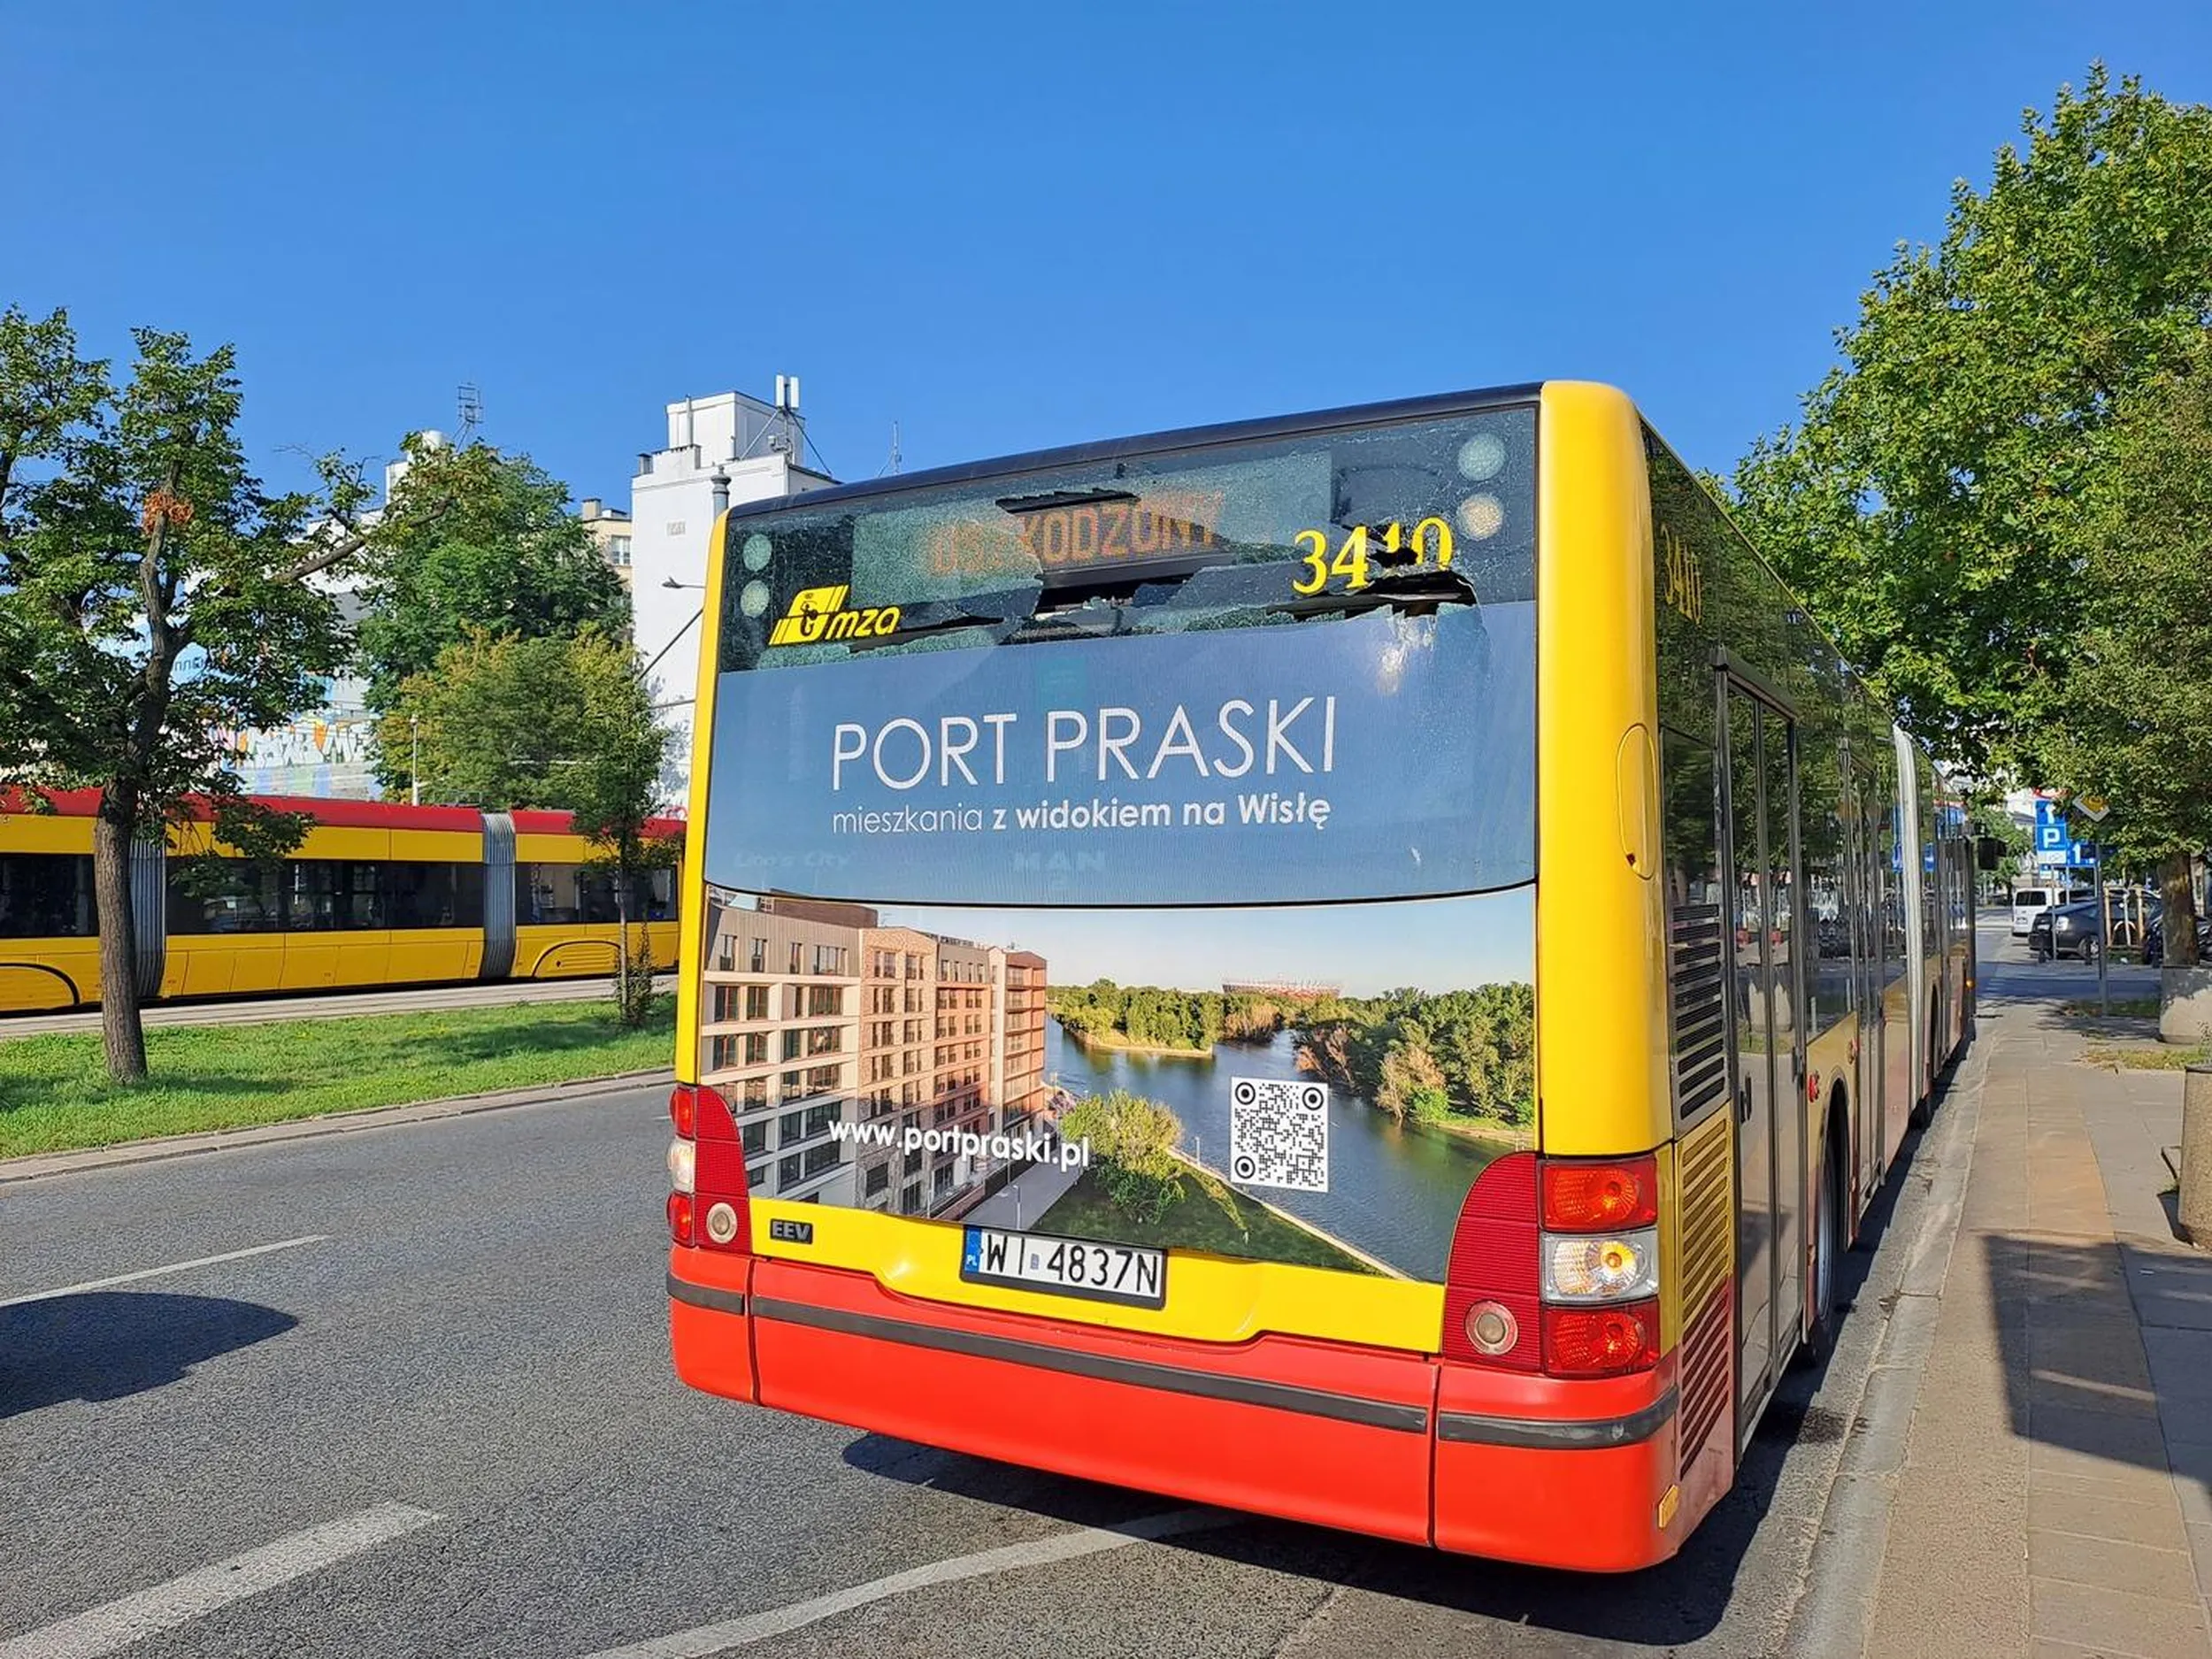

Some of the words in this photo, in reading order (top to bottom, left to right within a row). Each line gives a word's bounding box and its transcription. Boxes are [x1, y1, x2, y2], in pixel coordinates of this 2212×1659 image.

[825, 606, 901, 640] mza
[833, 713, 1018, 790] PORT
[1047, 696, 1335, 782] PRASKI
[833, 803, 982, 833] mieszkania
[993, 808, 1007, 829] z
[1016, 797, 1171, 830] widokiem
[1183, 802, 1225, 826] na
[1238, 792, 1332, 830] Wisłę
[2042, 828, 2061, 849] P
[1013, 849, 1106, 872] MAN
[828, 1120, 1088, 1171] www.portpraski.pl
[772, 1221, 810, 1240] EEV
[966, 1254, 978, 1266] PL
[987, 1234, 1025, 1275] WI
[1047, 1243, 1158, 1294] 4837N
